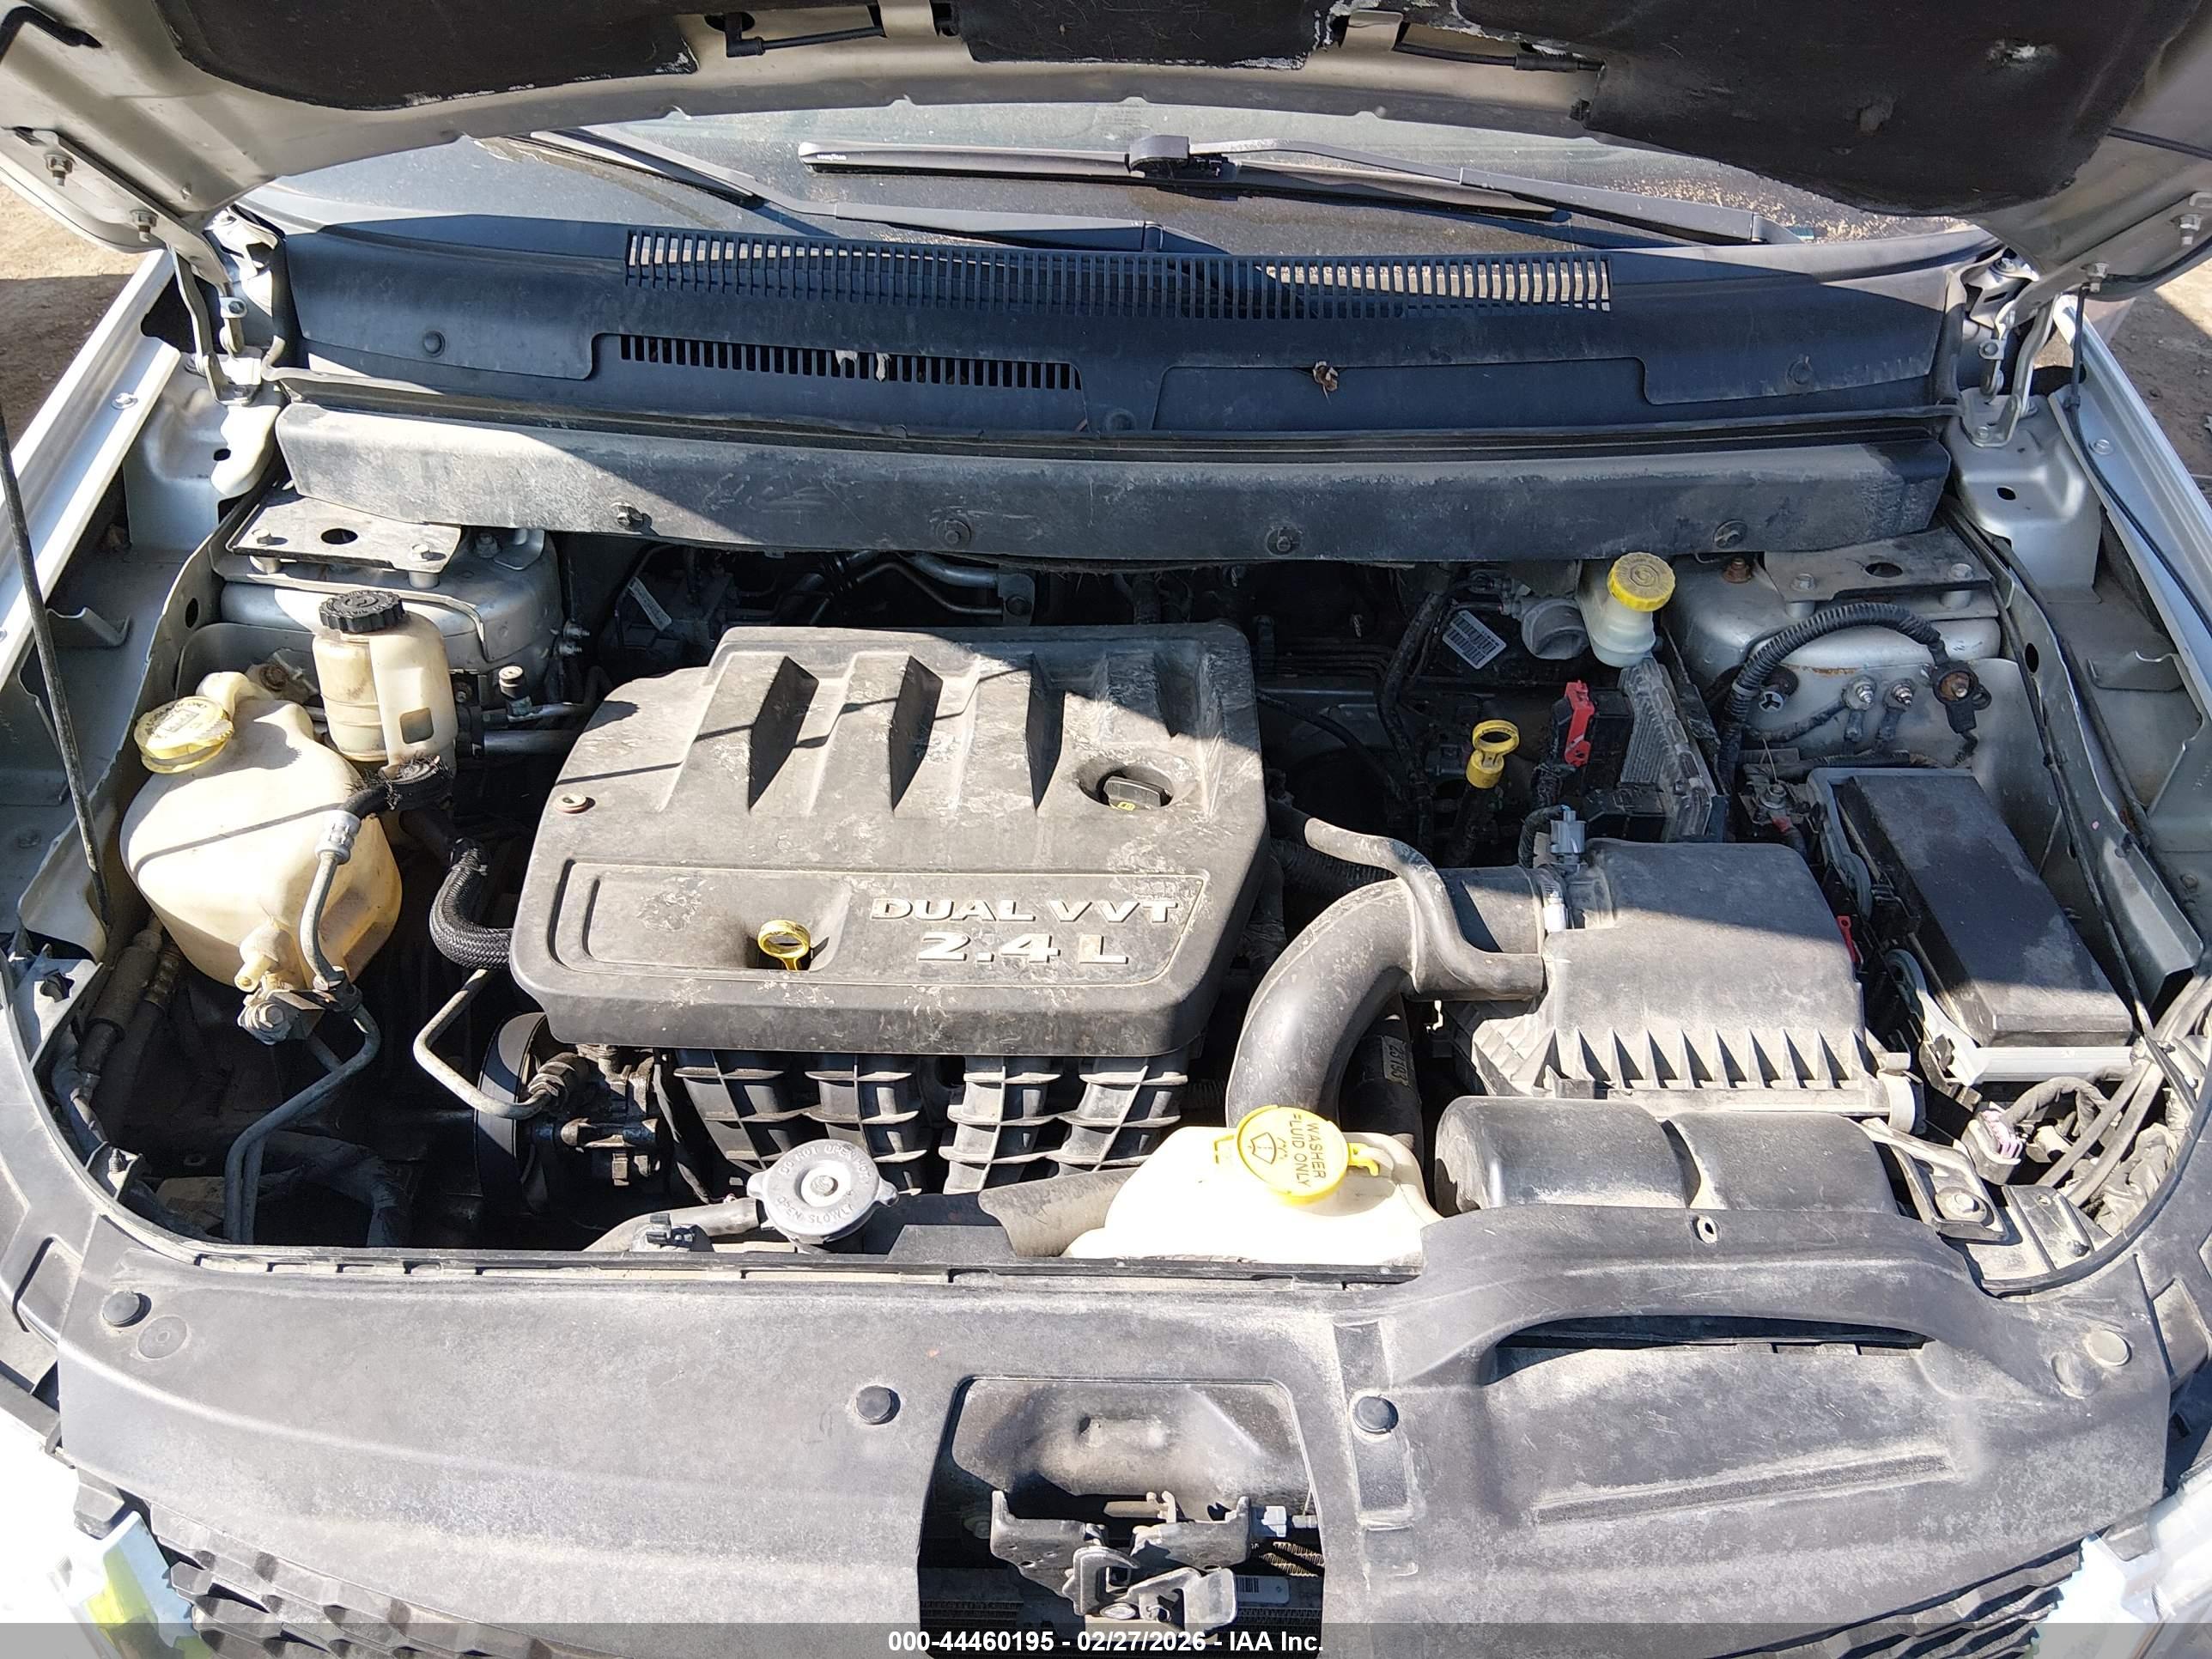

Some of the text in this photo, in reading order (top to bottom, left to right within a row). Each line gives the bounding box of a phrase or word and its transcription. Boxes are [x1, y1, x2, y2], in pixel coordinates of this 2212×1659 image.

[870, 898, 1178, 923] DUAL VVT
[917, 932, 1129, 964] 2.4 L
[780, 1159, 794, 1176] DO
[795, 1146, 818, 1163] NOT
[823, 1144, 857, 1162] OPEN
[1306, 1122, 1327, 1179] WASHER
[1294, 1152, 1311, 1188] ONLY
[777, 1196, 854, 1224] OPEN SLOWLY
